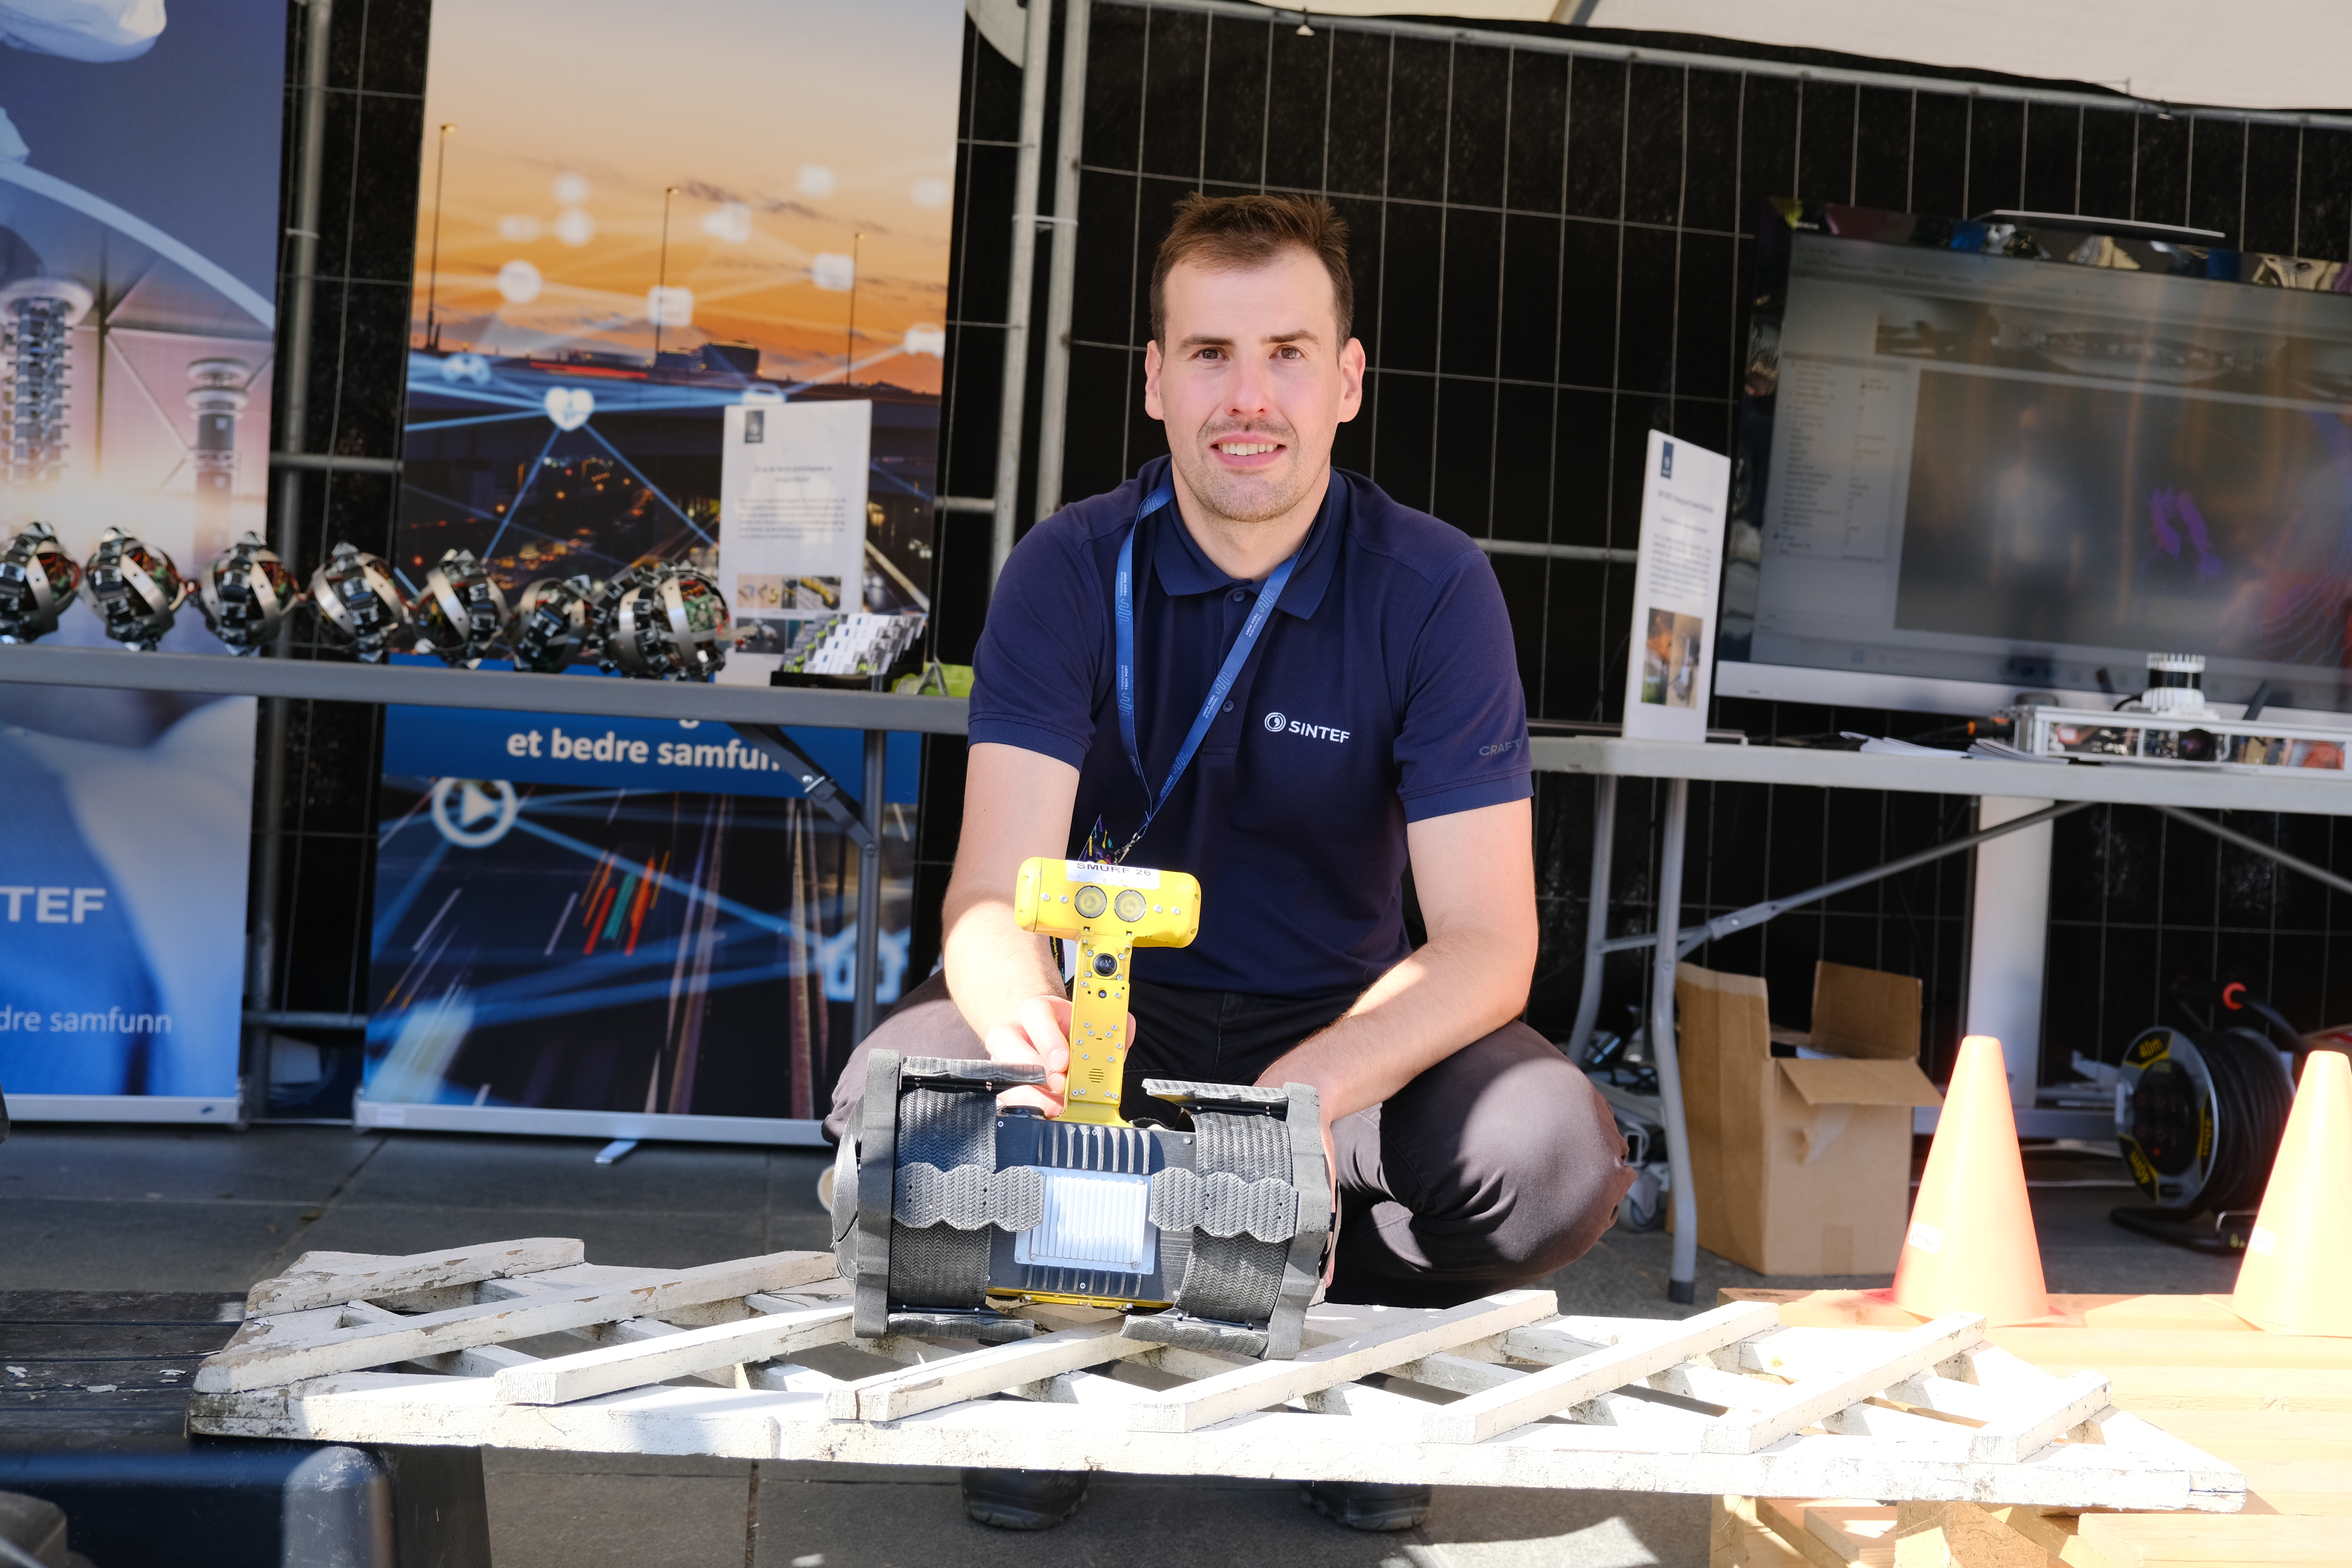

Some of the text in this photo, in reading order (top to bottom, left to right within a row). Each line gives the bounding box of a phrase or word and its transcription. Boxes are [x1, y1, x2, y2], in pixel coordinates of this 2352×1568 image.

[1248, 615, 1262, 637] TRONDHEIM
[1289, 721, 1350, 743] SINTEF
[507, 729, 543, 758] et
[551, 723, 649, 764] bedre
[1479, 739, 1521, 756] CRAFT
[1077, 863, 1130, 873] SMURF
[49, 1006, 172, 1034] samfunn
